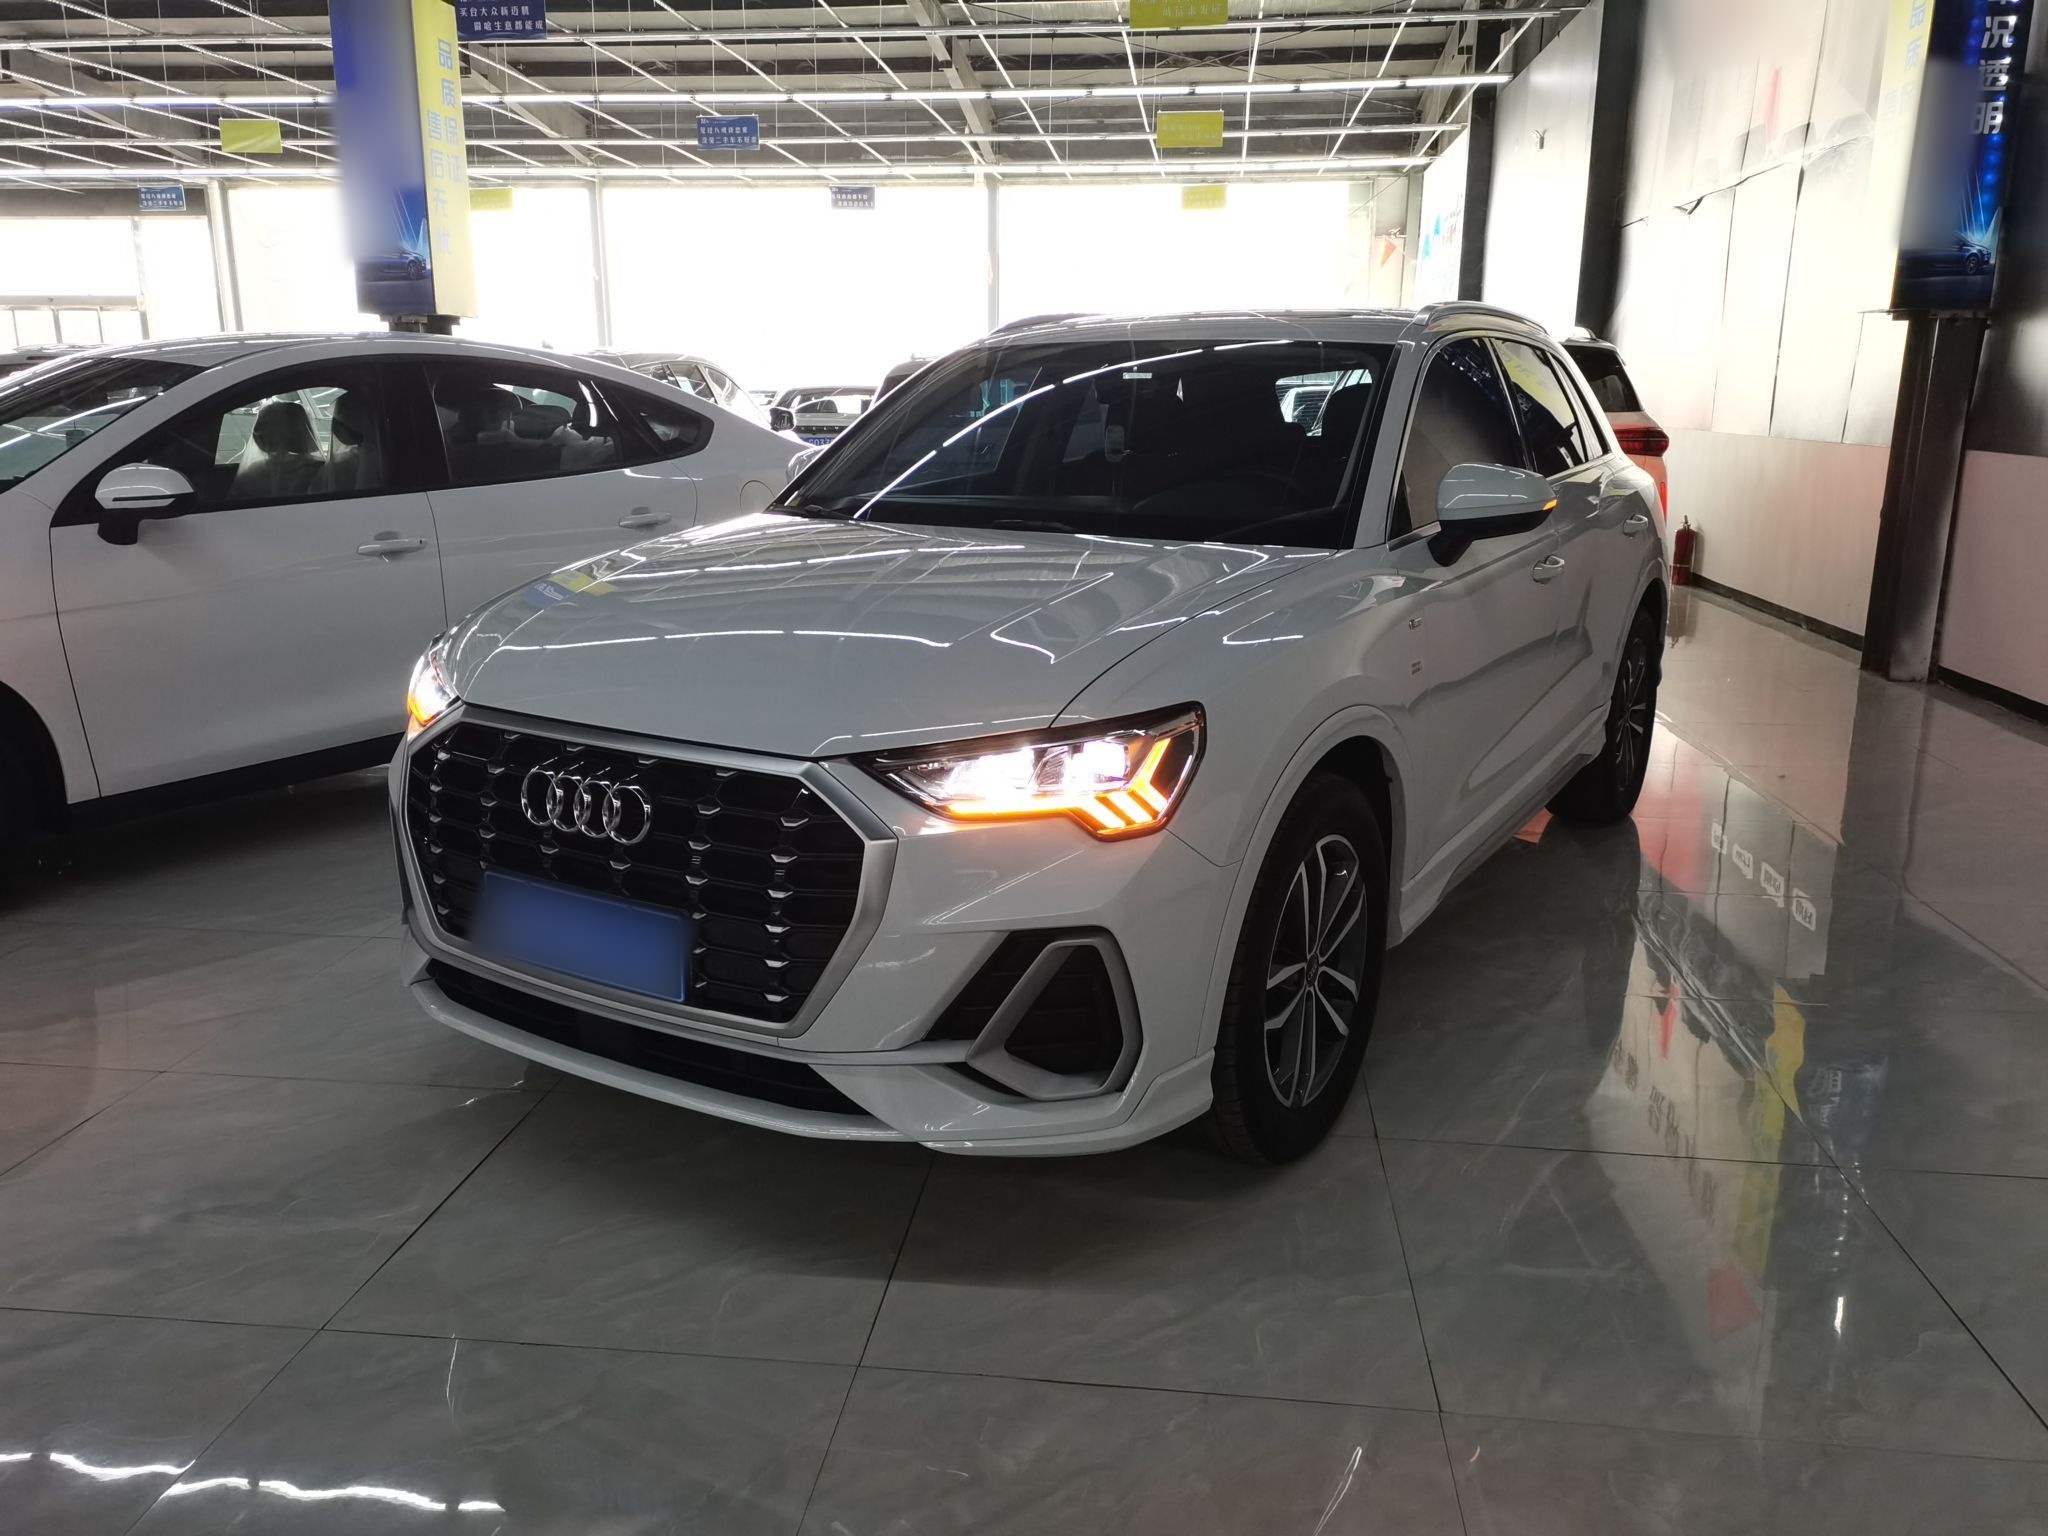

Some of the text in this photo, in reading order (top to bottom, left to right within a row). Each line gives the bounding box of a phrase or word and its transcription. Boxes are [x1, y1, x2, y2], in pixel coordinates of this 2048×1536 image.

[437, 38, 463, 184] 品质保证
[1969, 0, 2020, 134] 况透明
